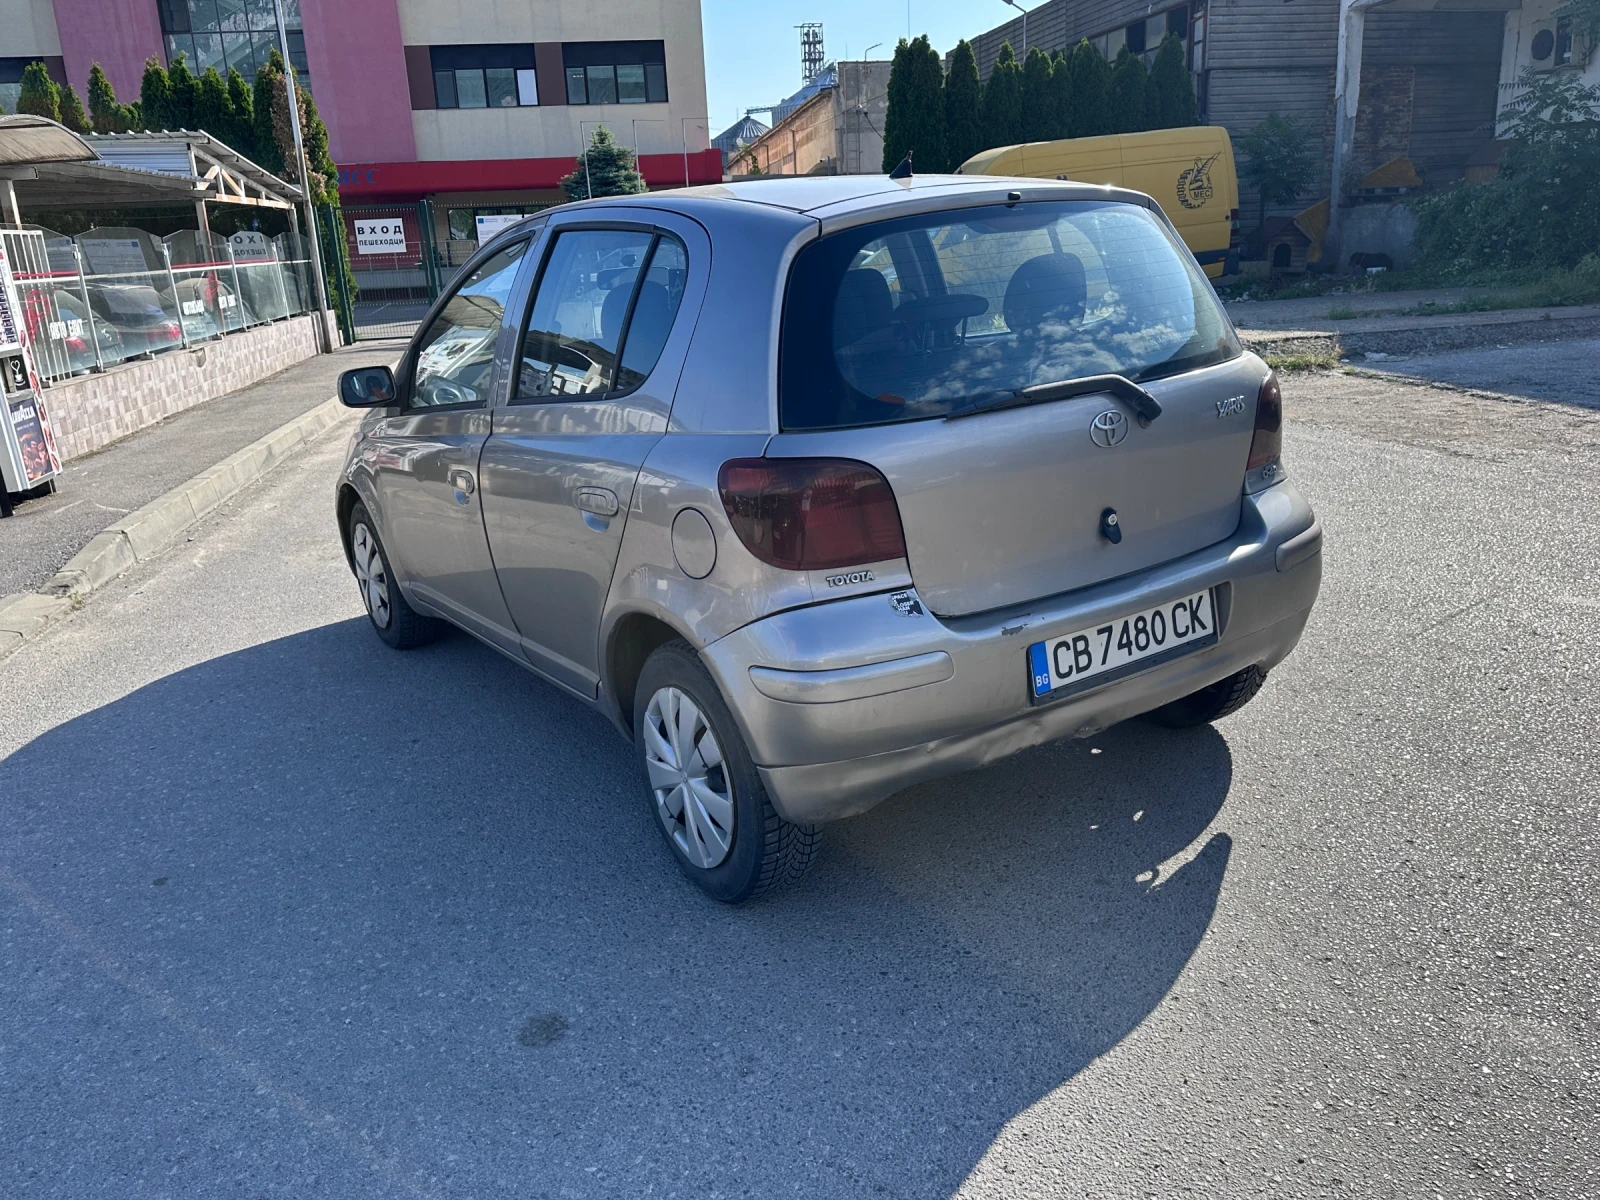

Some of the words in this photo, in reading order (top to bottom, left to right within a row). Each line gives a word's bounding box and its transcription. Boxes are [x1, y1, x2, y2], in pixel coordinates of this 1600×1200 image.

[357, 225, 402, 235] ВХОД
[358, 238, 404, 246] ПЕШЕХОДЦИ
[826, 571, 875, 587] TOYOTA
[1053, 634, 1093, 679] CB
[1097, 610, 1166, 666] 7480
[1171, 595, 1208, 638] CK
[1035, 673, 1049, 687] BG
